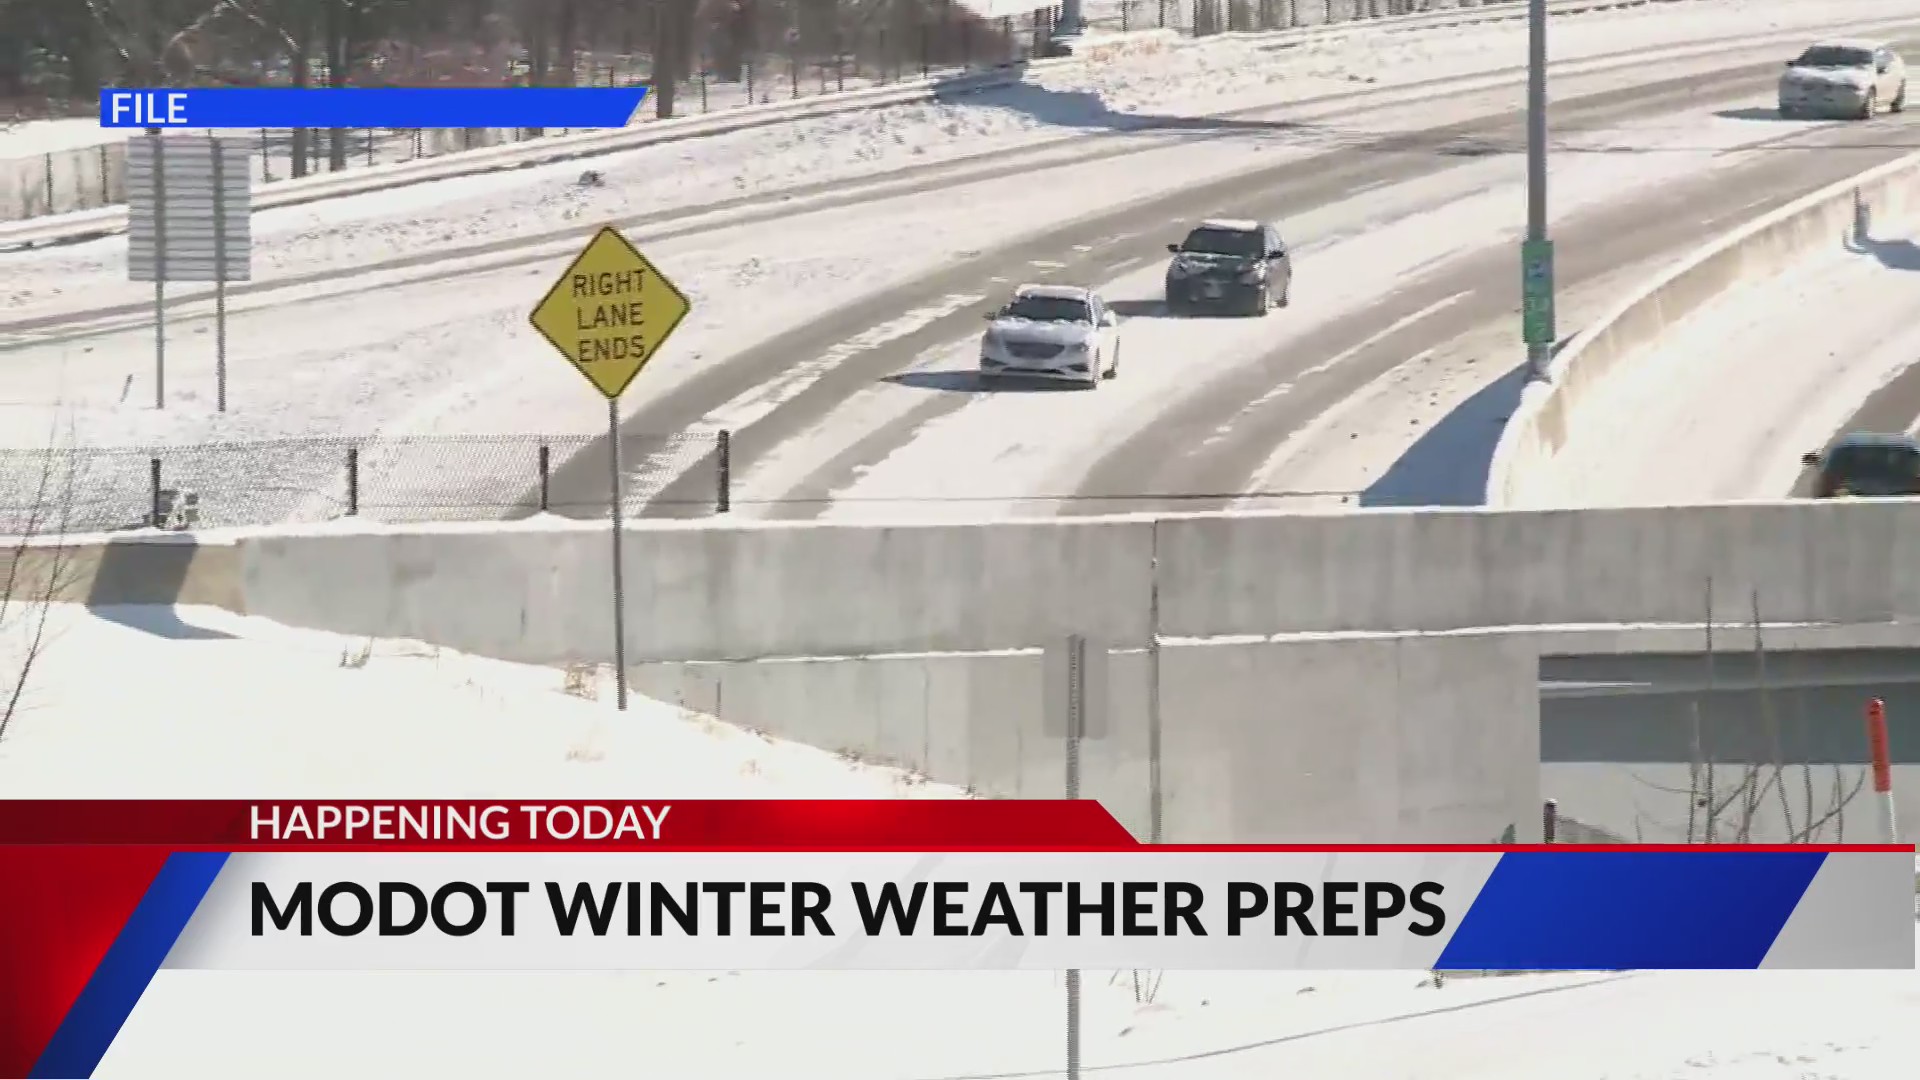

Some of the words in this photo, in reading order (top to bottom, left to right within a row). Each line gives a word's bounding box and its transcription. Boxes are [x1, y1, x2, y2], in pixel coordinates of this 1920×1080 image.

[573, 268, 645, 297] RIGHT
[577, 302, 645, 330] LANE
[578, 334, 645, 362] ENDS
